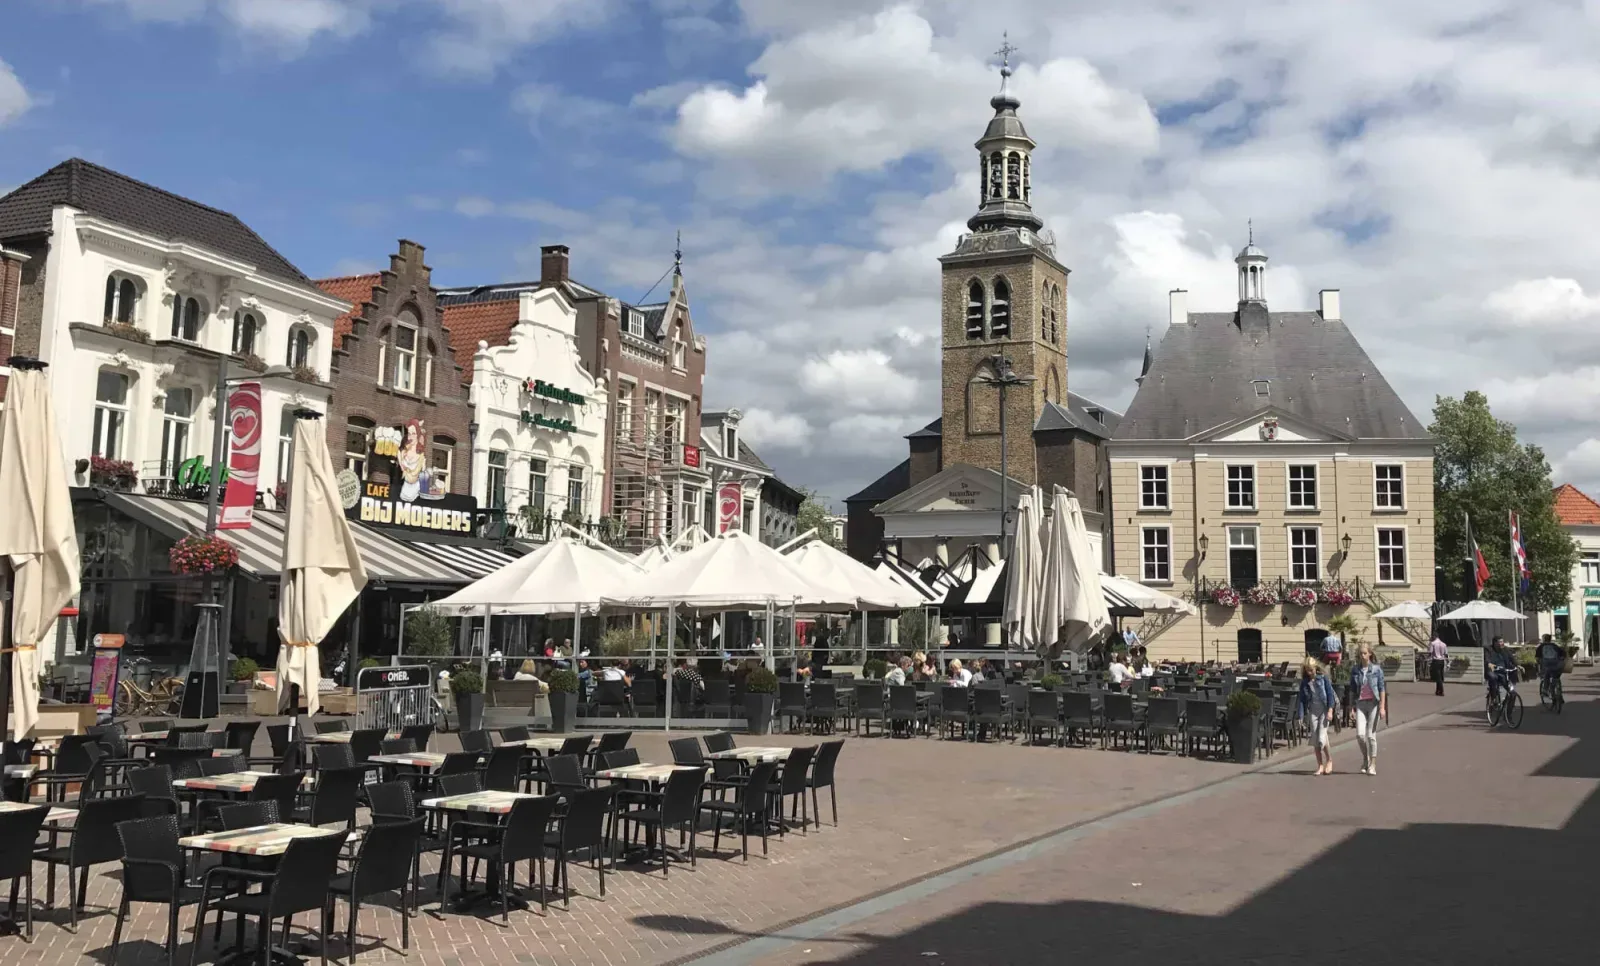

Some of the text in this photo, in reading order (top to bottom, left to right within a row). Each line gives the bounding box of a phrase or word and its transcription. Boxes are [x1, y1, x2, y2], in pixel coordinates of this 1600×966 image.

[533, 379, 586, 405] Heineken
[367, 483, 390, 498] CAFÉ
[360, 496, 472, 532] BIJ MOEDERS
